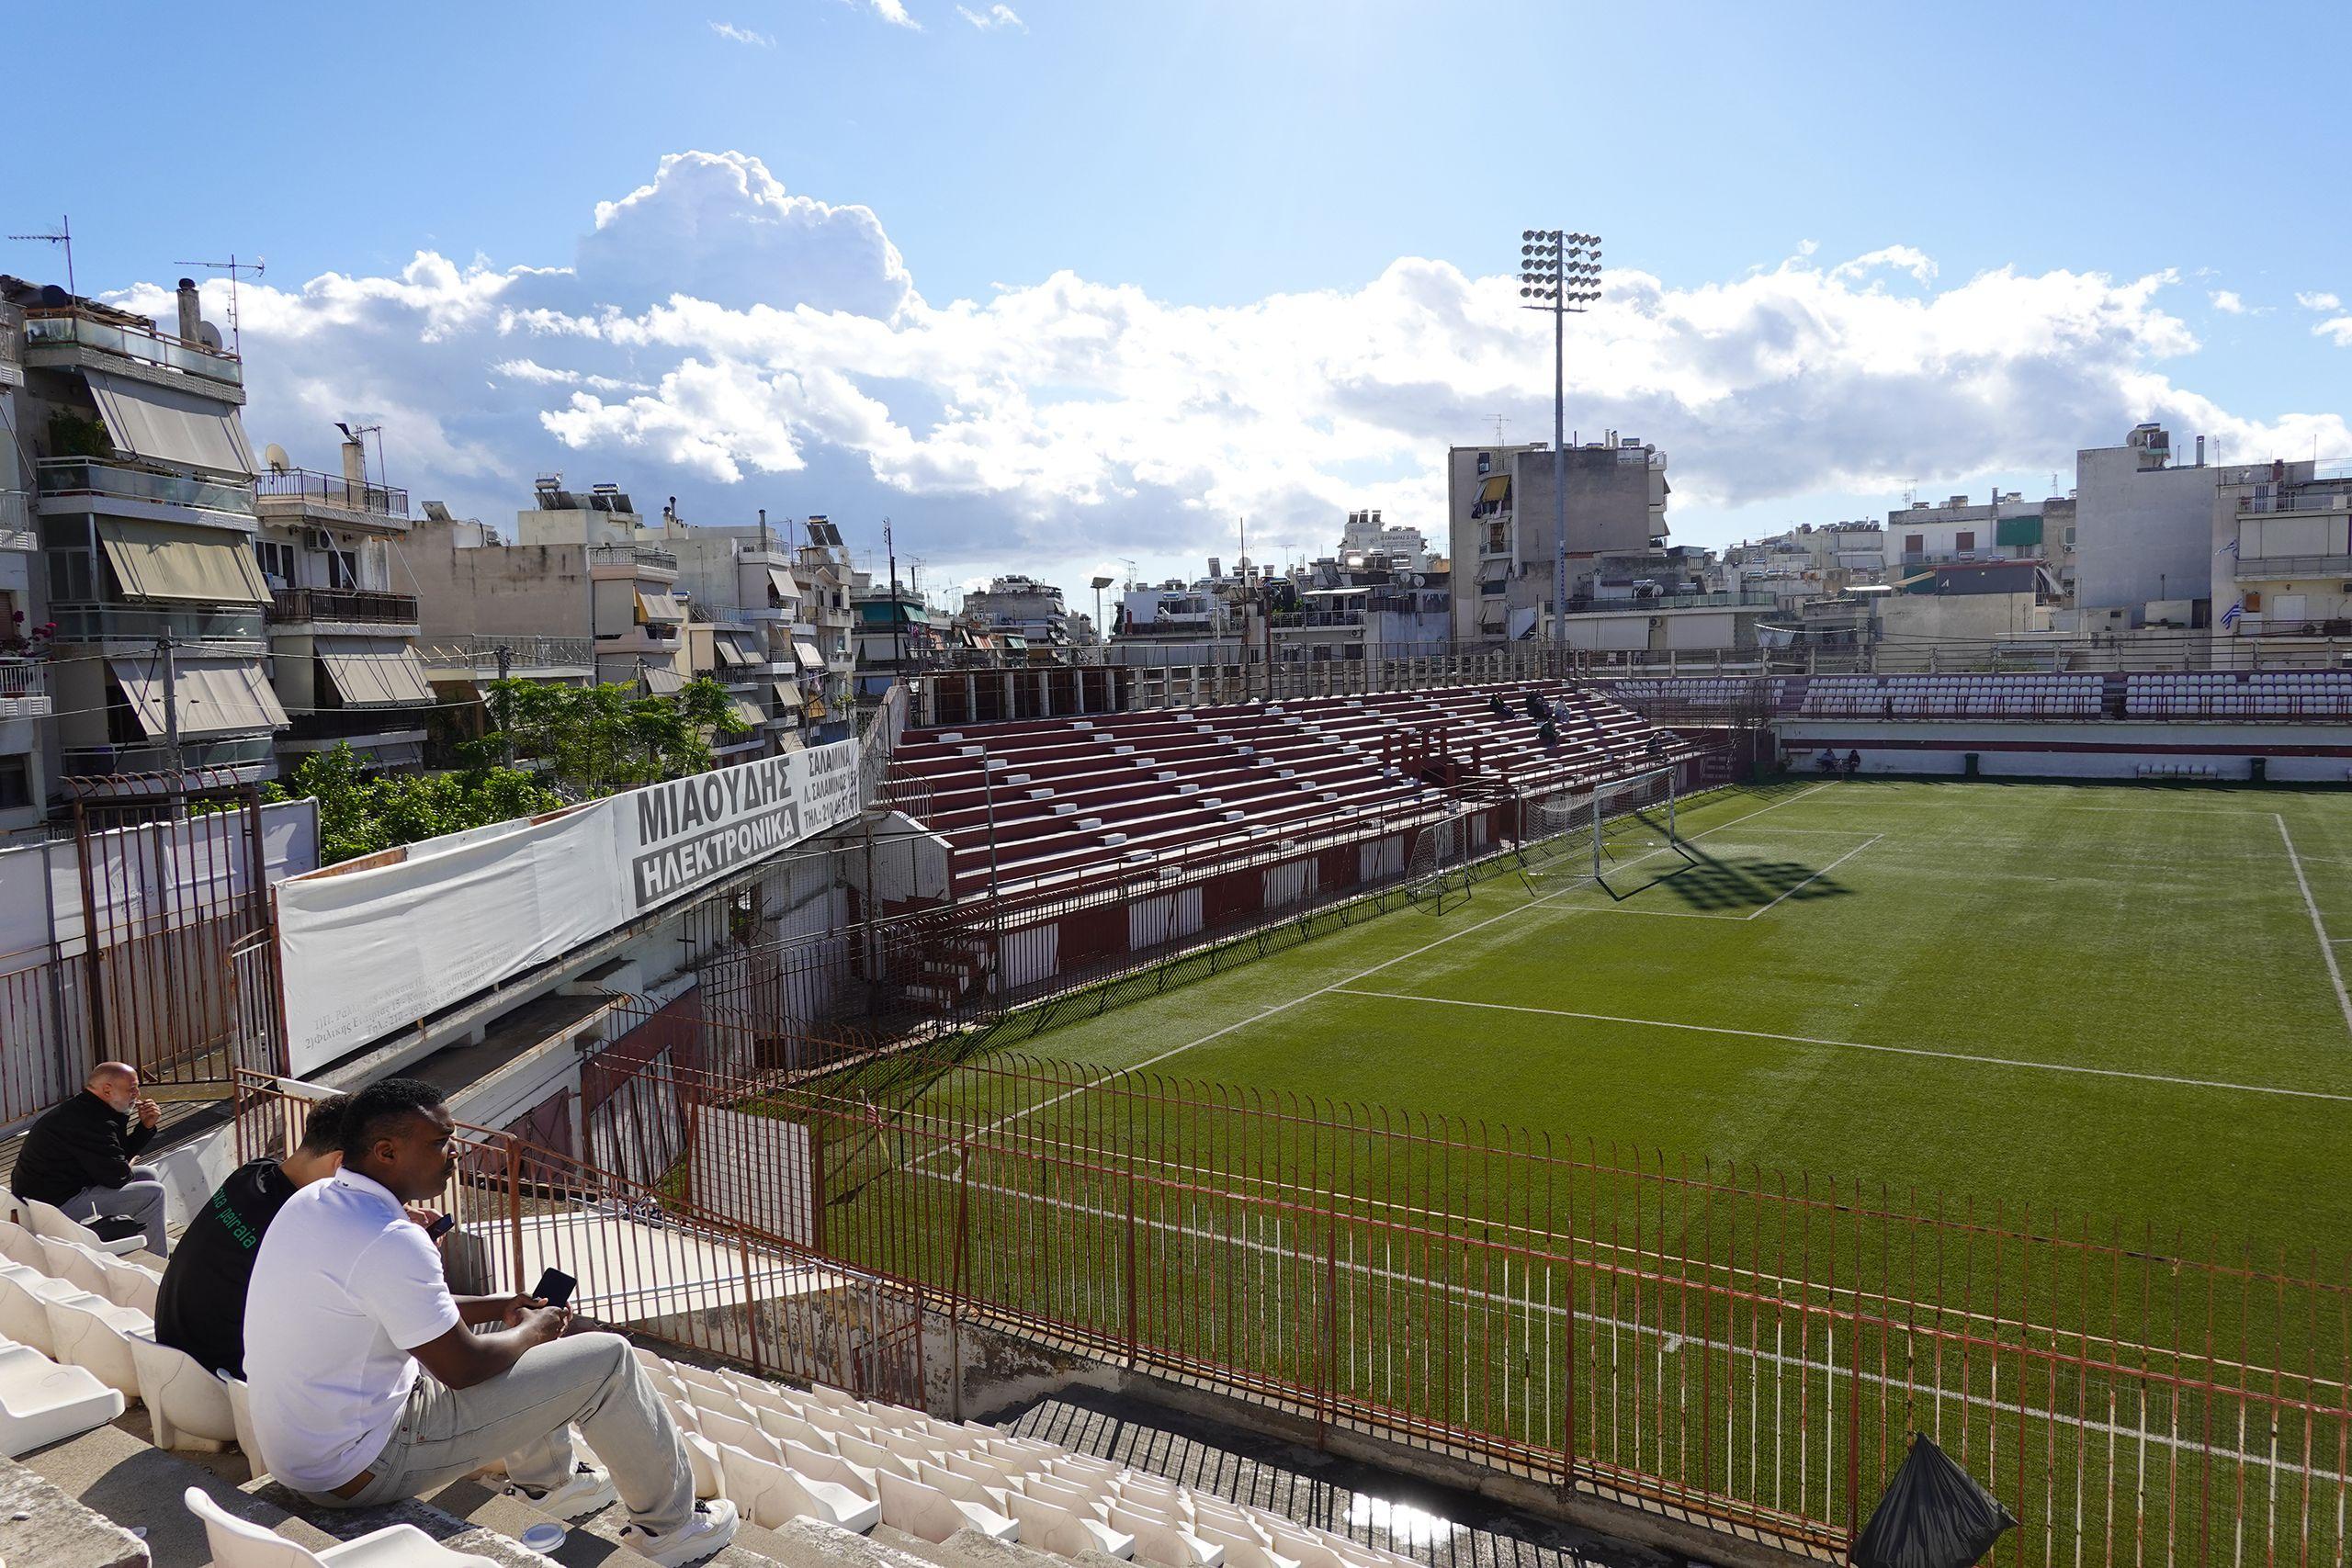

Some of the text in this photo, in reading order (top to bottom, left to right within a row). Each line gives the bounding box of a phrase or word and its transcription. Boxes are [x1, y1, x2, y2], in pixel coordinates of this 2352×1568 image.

[808, 745, 851, 777] ΣΑΛΑΜΙΝΑ
[637, 757, 792, 846] ΜΙΑΟΥΔΗΣ
[822, 801, 833, 821] 210
[643, 809, 796, 897] ΗΛΕΚΤΡΟΝΙΚΑ
[215, 1206, 257, 1248] peiraia
